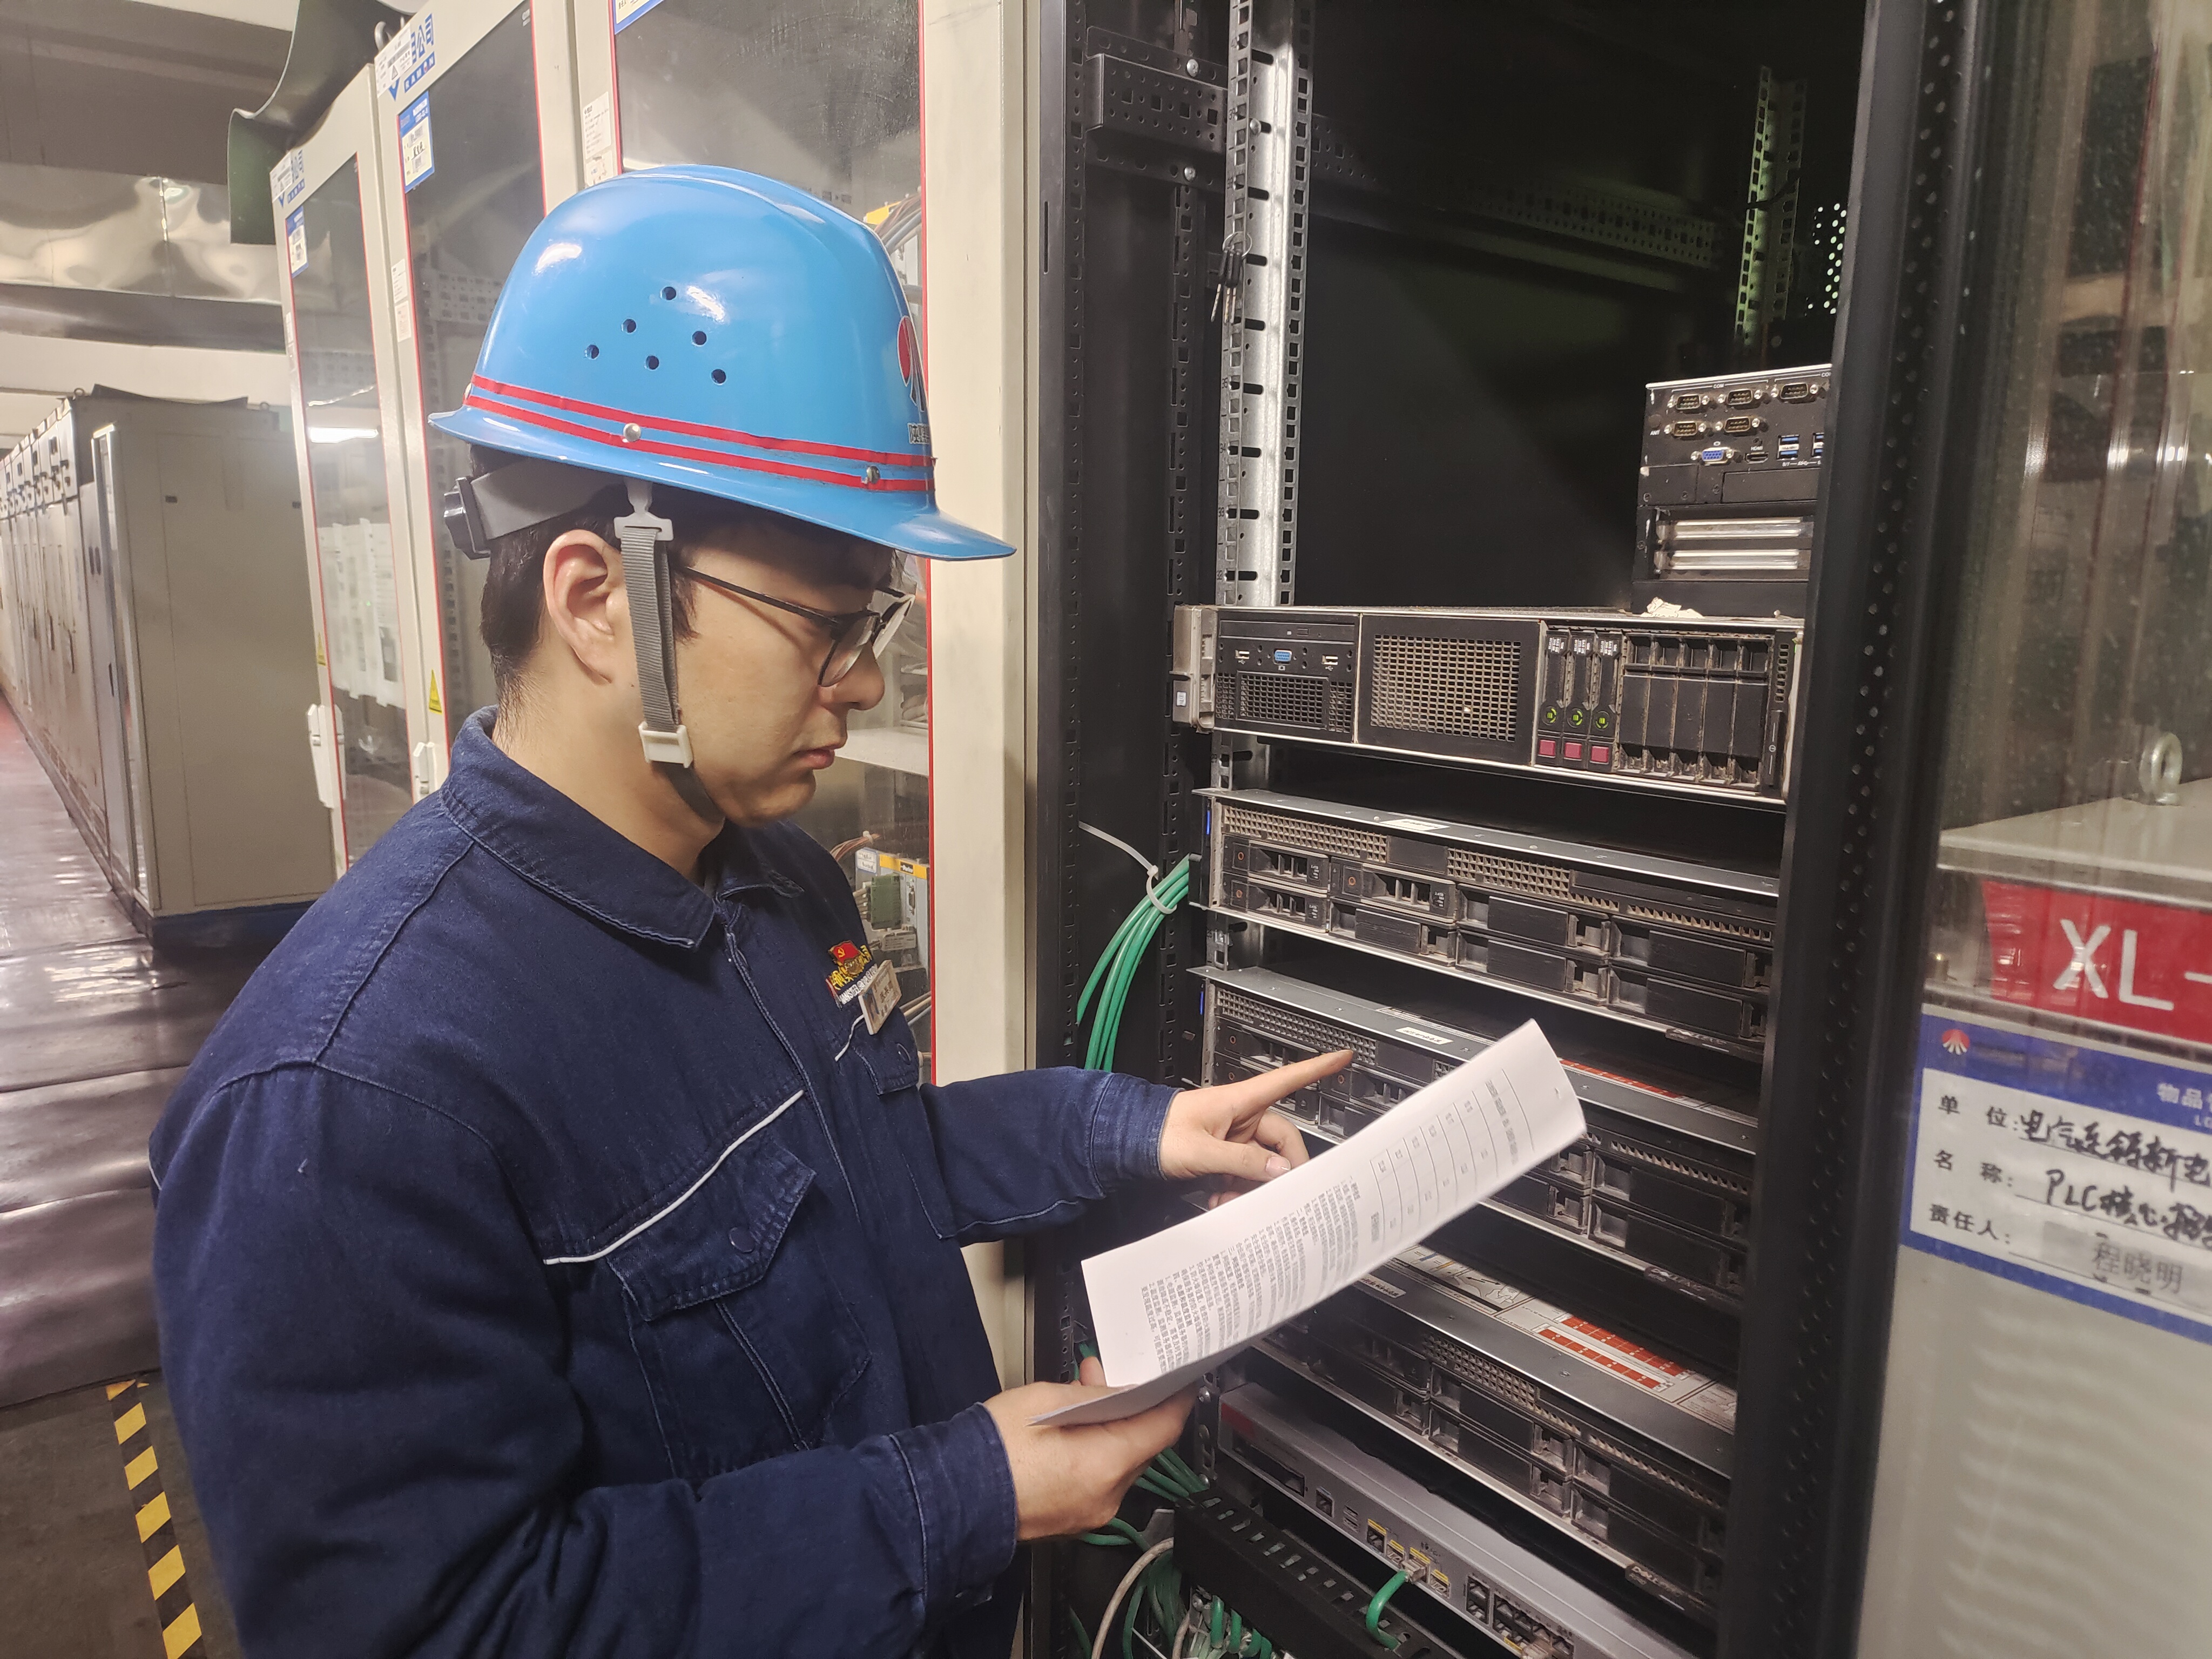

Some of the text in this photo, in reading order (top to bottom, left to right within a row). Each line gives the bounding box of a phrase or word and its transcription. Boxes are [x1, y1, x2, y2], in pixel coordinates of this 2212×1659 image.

[406, 56, 434, 91] RAMON
[1219, 443, 1226, 454] 34
[1218, 507, 1224, 517] 33
[1217, 570, 1223, 580] 32
[1938, 1095, 1960, 1114] 单
[2157, 1083, 2212, 1113] 物品
[1933, 1150, 1953, 1170] 名
[1930, 1204, 2011, 1244] 责任人：
